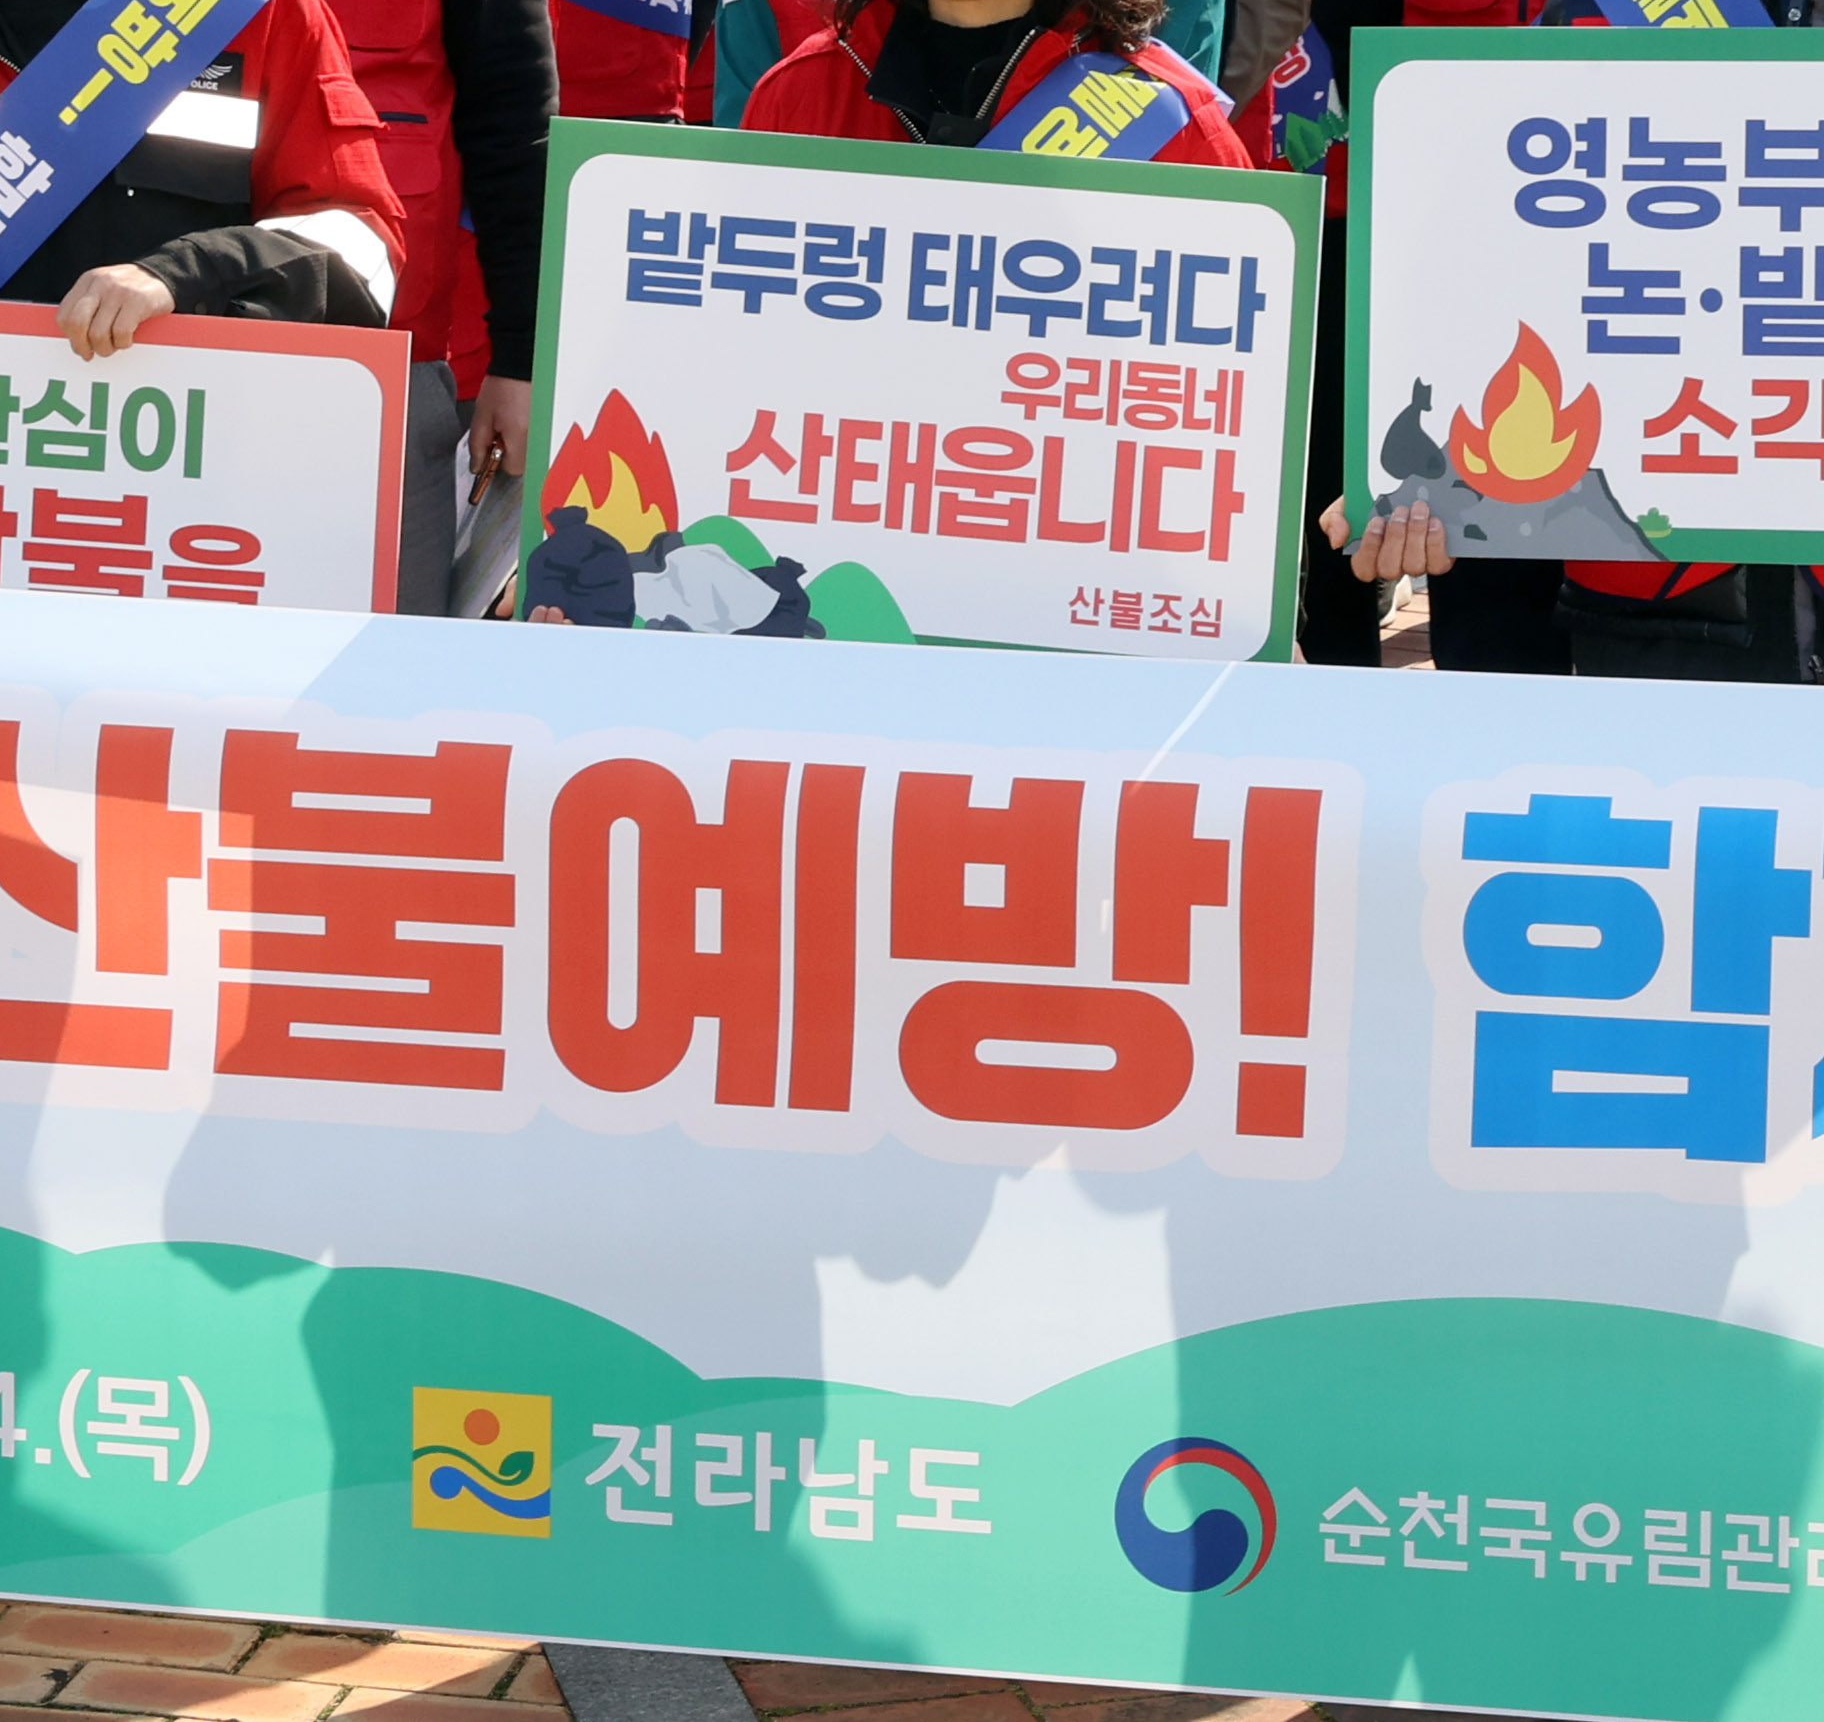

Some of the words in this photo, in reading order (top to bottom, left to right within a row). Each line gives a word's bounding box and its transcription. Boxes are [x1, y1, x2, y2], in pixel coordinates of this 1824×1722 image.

[626, 209, 886, 320] 밭두렁
[907, 231, 1266, 353] 태우려다
[1000, 352, 1244, 437] 우리동네
[726, 409, 1245, 562] 산태웁니다
[1069, 585, 1224, 639] 산불조심
[585, 1423, 992, 1542] 전라남도
